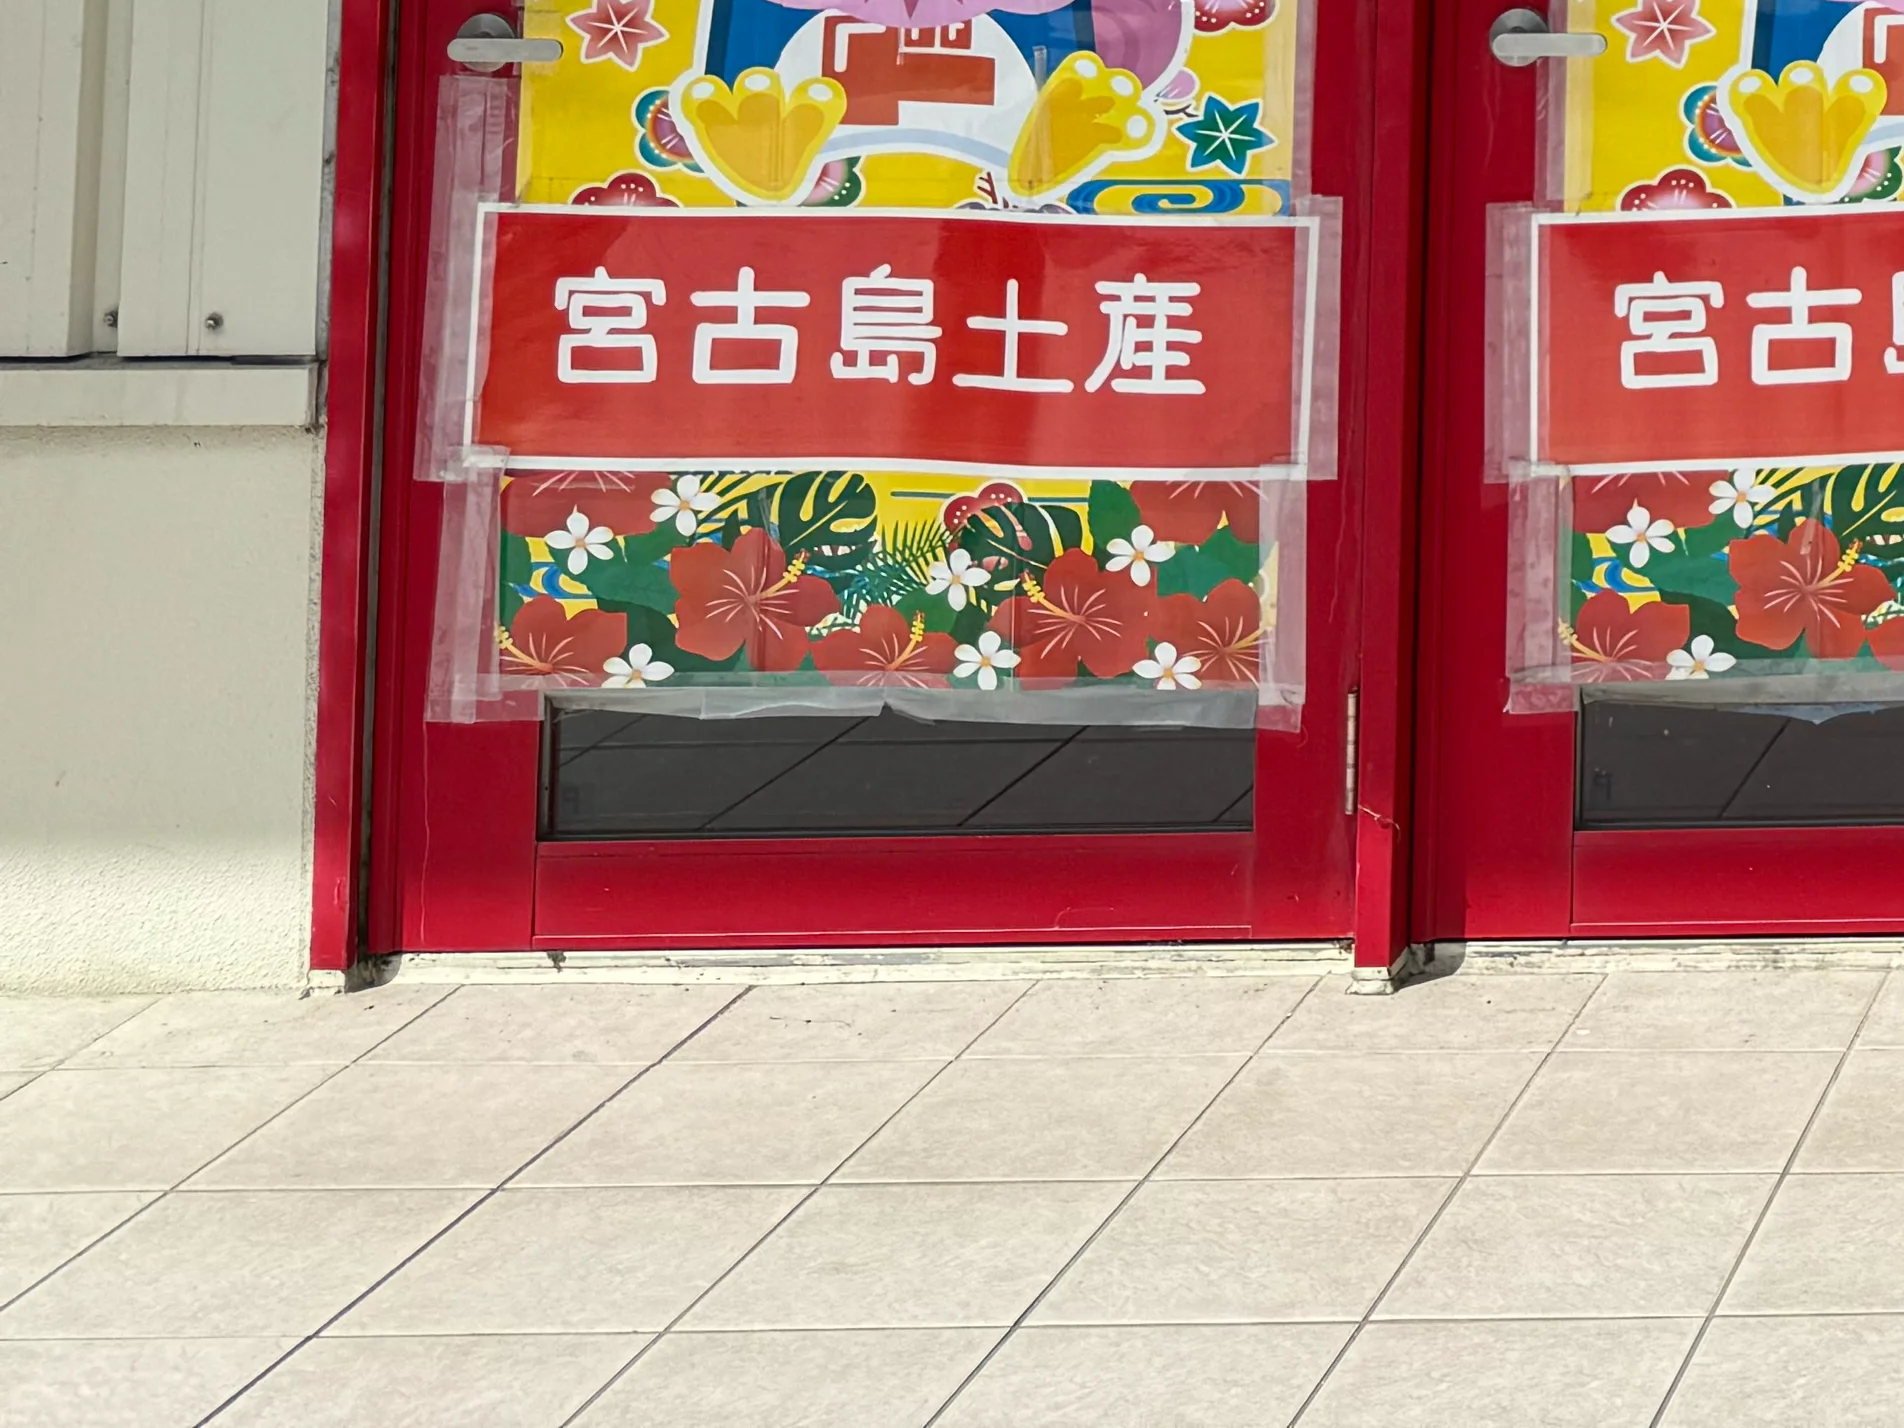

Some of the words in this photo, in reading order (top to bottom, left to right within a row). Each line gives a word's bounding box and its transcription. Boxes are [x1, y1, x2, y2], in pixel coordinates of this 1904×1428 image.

[553, 264, 1206, 395] 宮古島土産
